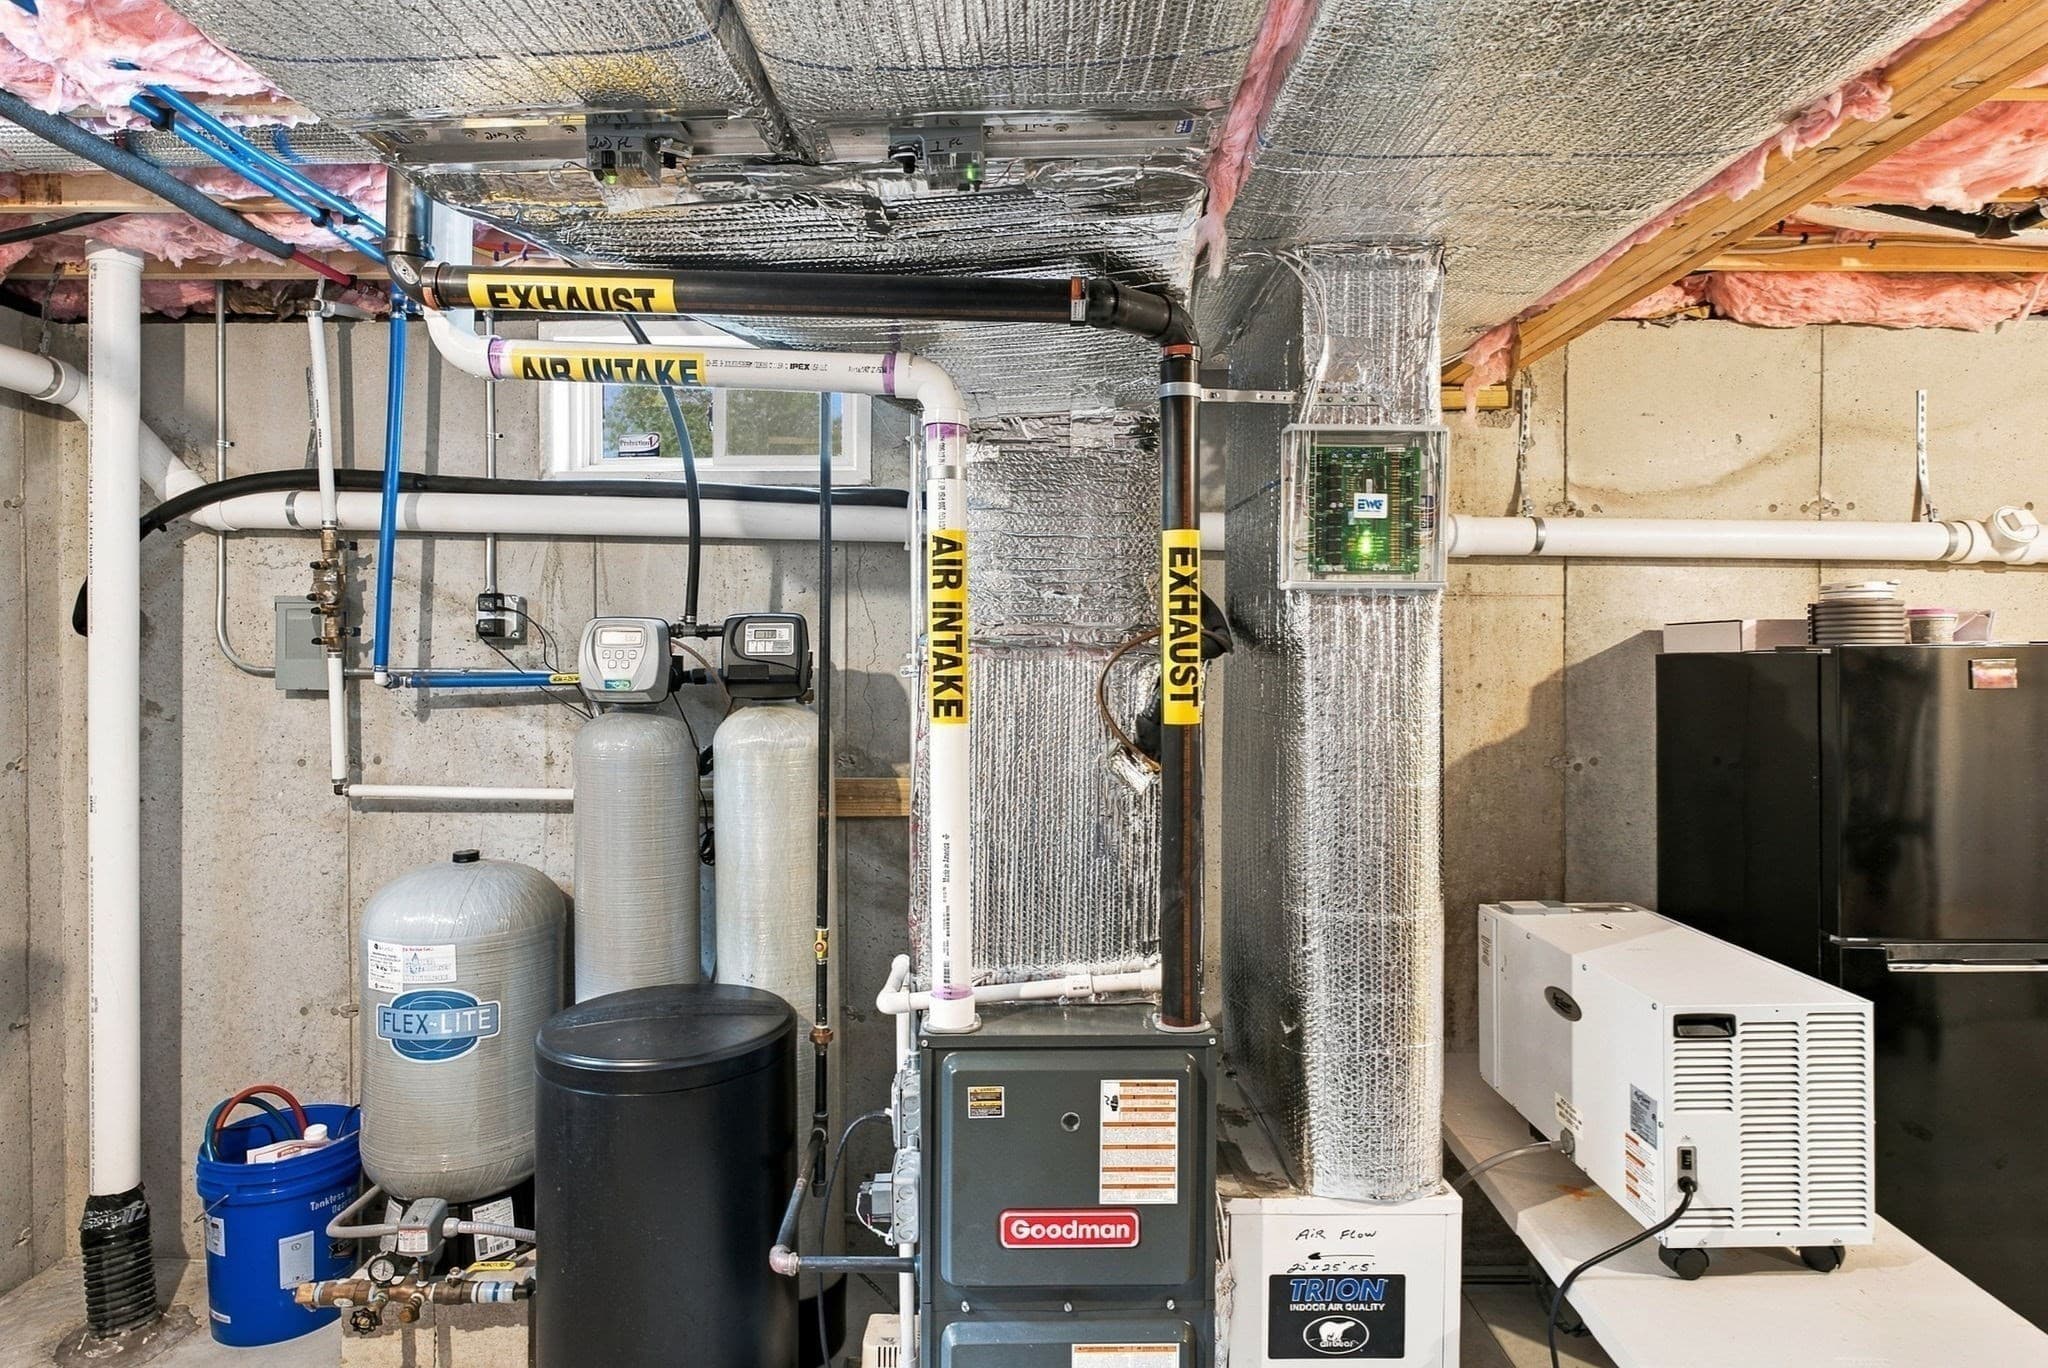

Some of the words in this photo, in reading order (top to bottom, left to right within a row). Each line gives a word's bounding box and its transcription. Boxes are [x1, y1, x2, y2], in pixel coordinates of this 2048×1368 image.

[486, 284, 656, 312] EXHAUST
[522, 356, 577, 381] AIR
[582, 357, 700, 385] INTAKE
[932, 535, 963, 590] AIR
[1168, 547, 1199, 708] EXHAUST
[932, 601, 964, 719] INTAKE
[1010, 1219, 1130, 1240] Goodman
[1289, 1278, 1385, 1302] TRION
[1289, 1303, 1326, 1312] INDOOR
[1328, 1303, 1343, 1312] AIR
[1345, 1303, 1386, 1312] QUALITY
